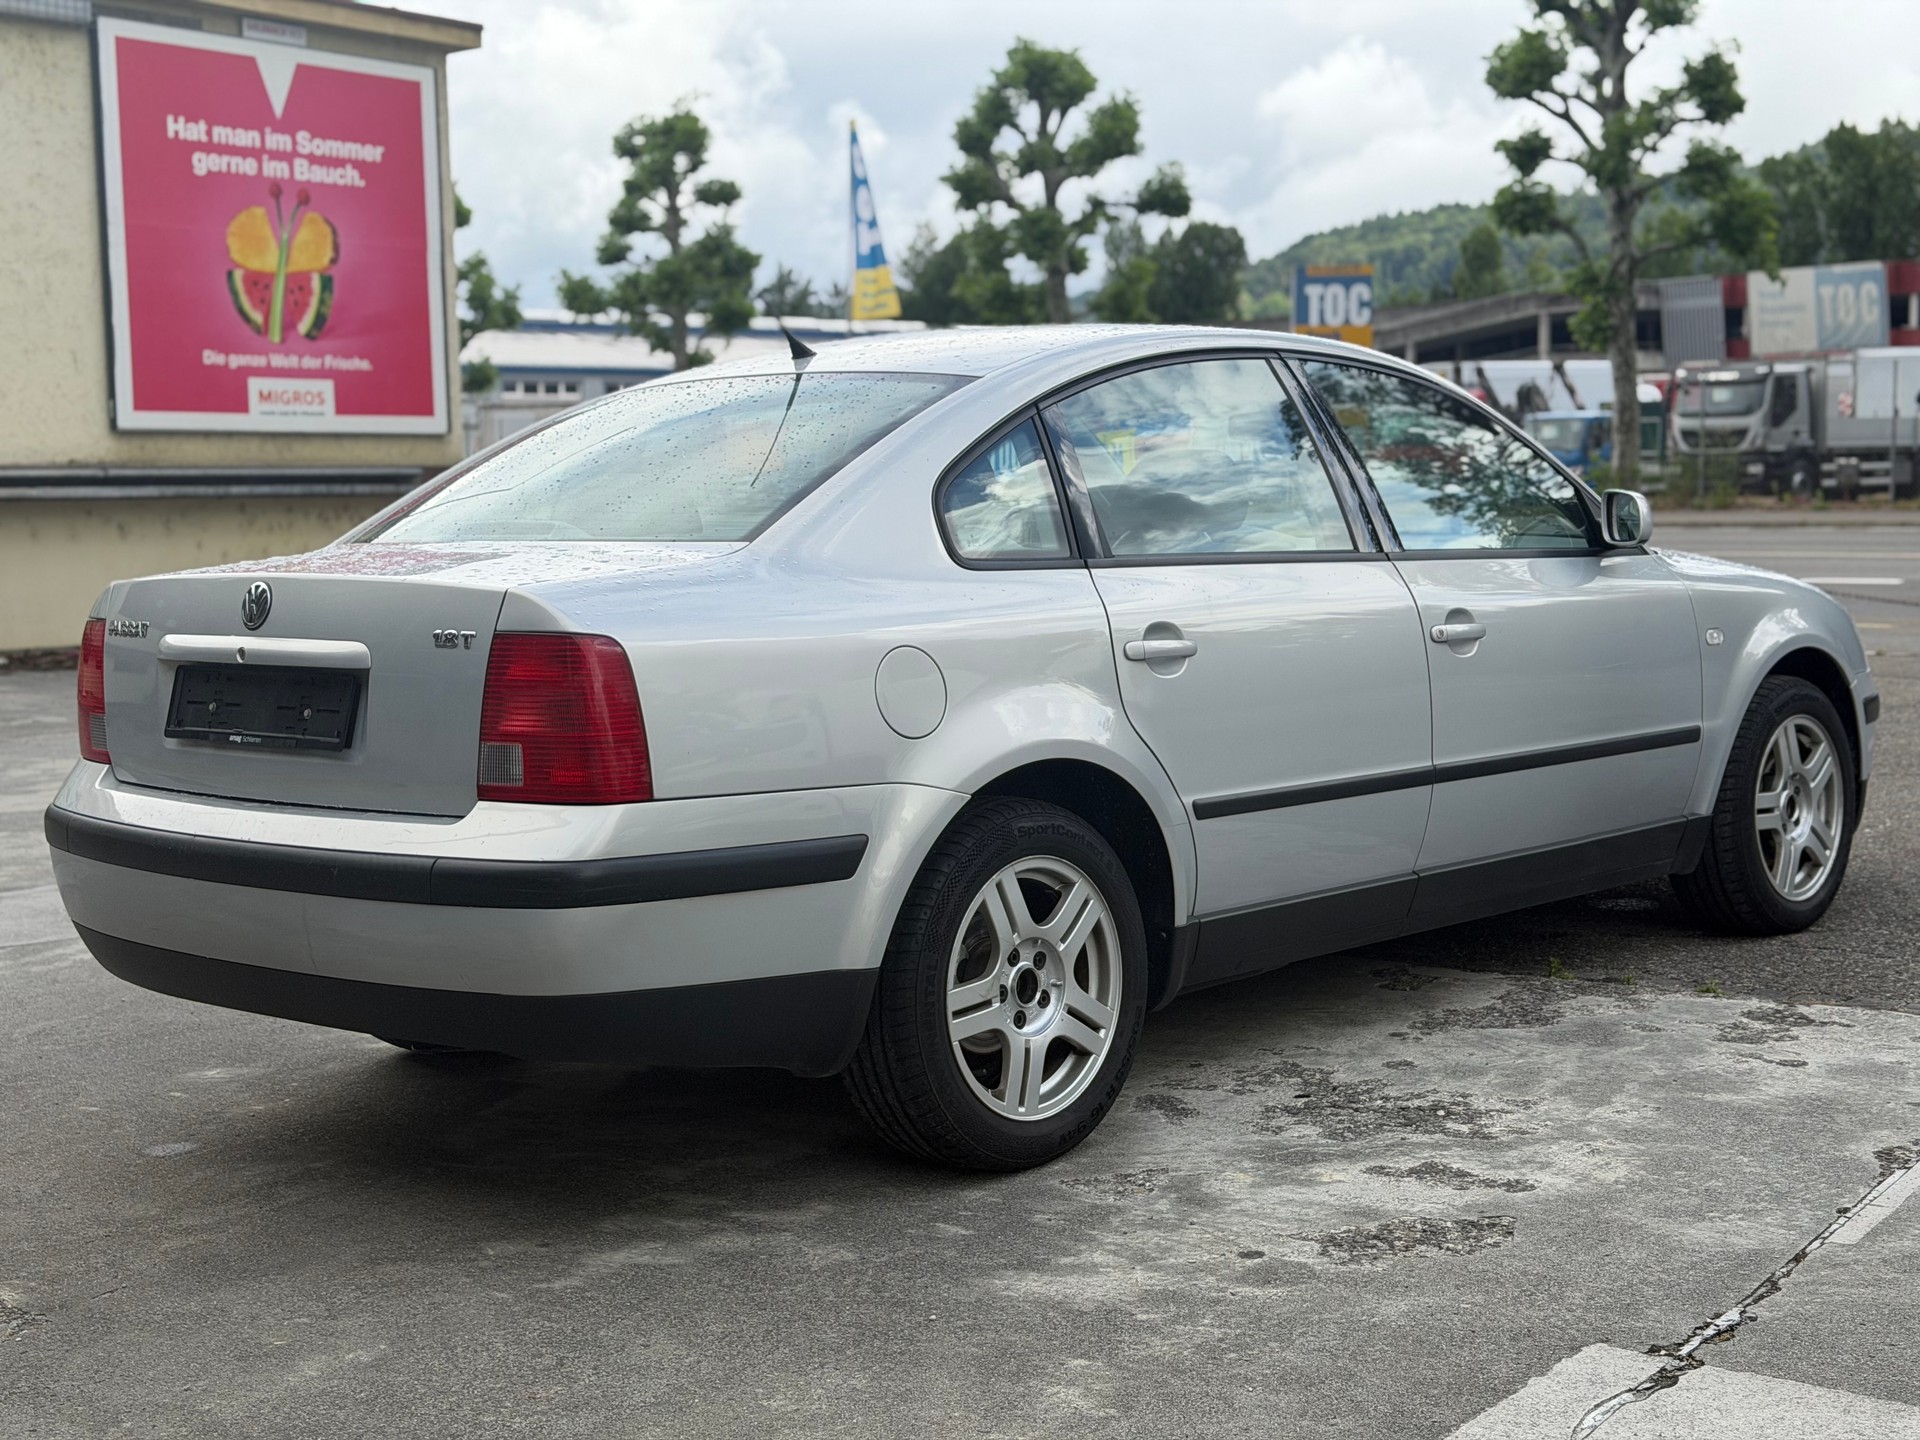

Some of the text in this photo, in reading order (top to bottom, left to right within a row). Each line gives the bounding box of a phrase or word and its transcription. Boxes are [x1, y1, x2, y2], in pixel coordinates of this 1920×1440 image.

[166, 113, 385, 163] Hat man im Sommer
[191, 150, 366, 188] gerne im Bauch.
[1304, 281, 1372, 328] TOC
[1818, 281, 1881, 333] TOC
[202, 349, 226, 366] Die
[269, 352, 300, 369] Welt
[301, 355, 322, 370] der
[258, 389, 325, 406] MIGROS
